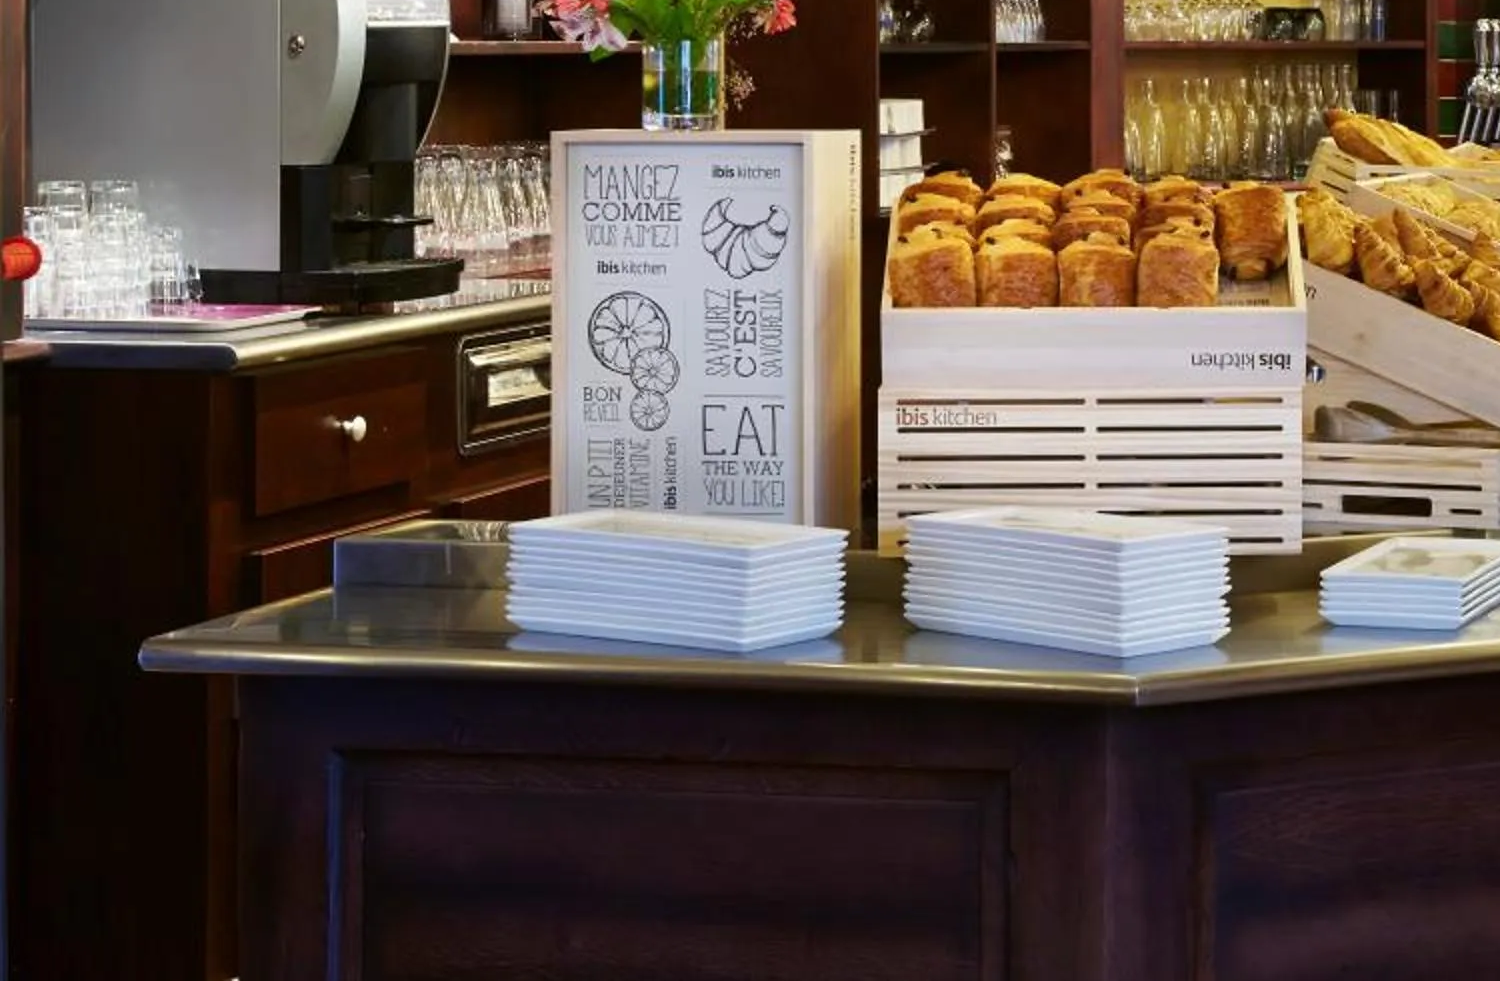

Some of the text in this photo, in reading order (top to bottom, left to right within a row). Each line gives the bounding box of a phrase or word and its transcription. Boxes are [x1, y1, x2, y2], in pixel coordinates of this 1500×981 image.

[584, 164, 680, 200] MANGEZ
[712, 164, 781, 179] ibis kitchen
[582, 202, 682, 221] COMME
[585, 224, 617, 247] VOUS
[597, 260, 667, 276] ibis kitchen
[704, 289, 730, 378] SAVOUREZ
[733, 290, 757, 378] C'EST
[760, 289, 783, 378] SAVOUREUX
[1191, 352, 1292, 371] ibis kitchen
[583, 386, 622, 401] BON
[896, 407, 998, 426] ibis kitchen
[702, 405, 785, 456] EAT
[664, 436, 677, 510] ibis kitchen
[702, 461, 784, 476] THE WAY
[587, 484, 612, 508] UN
[703, 479, 785, 507] YOU LIKE!
